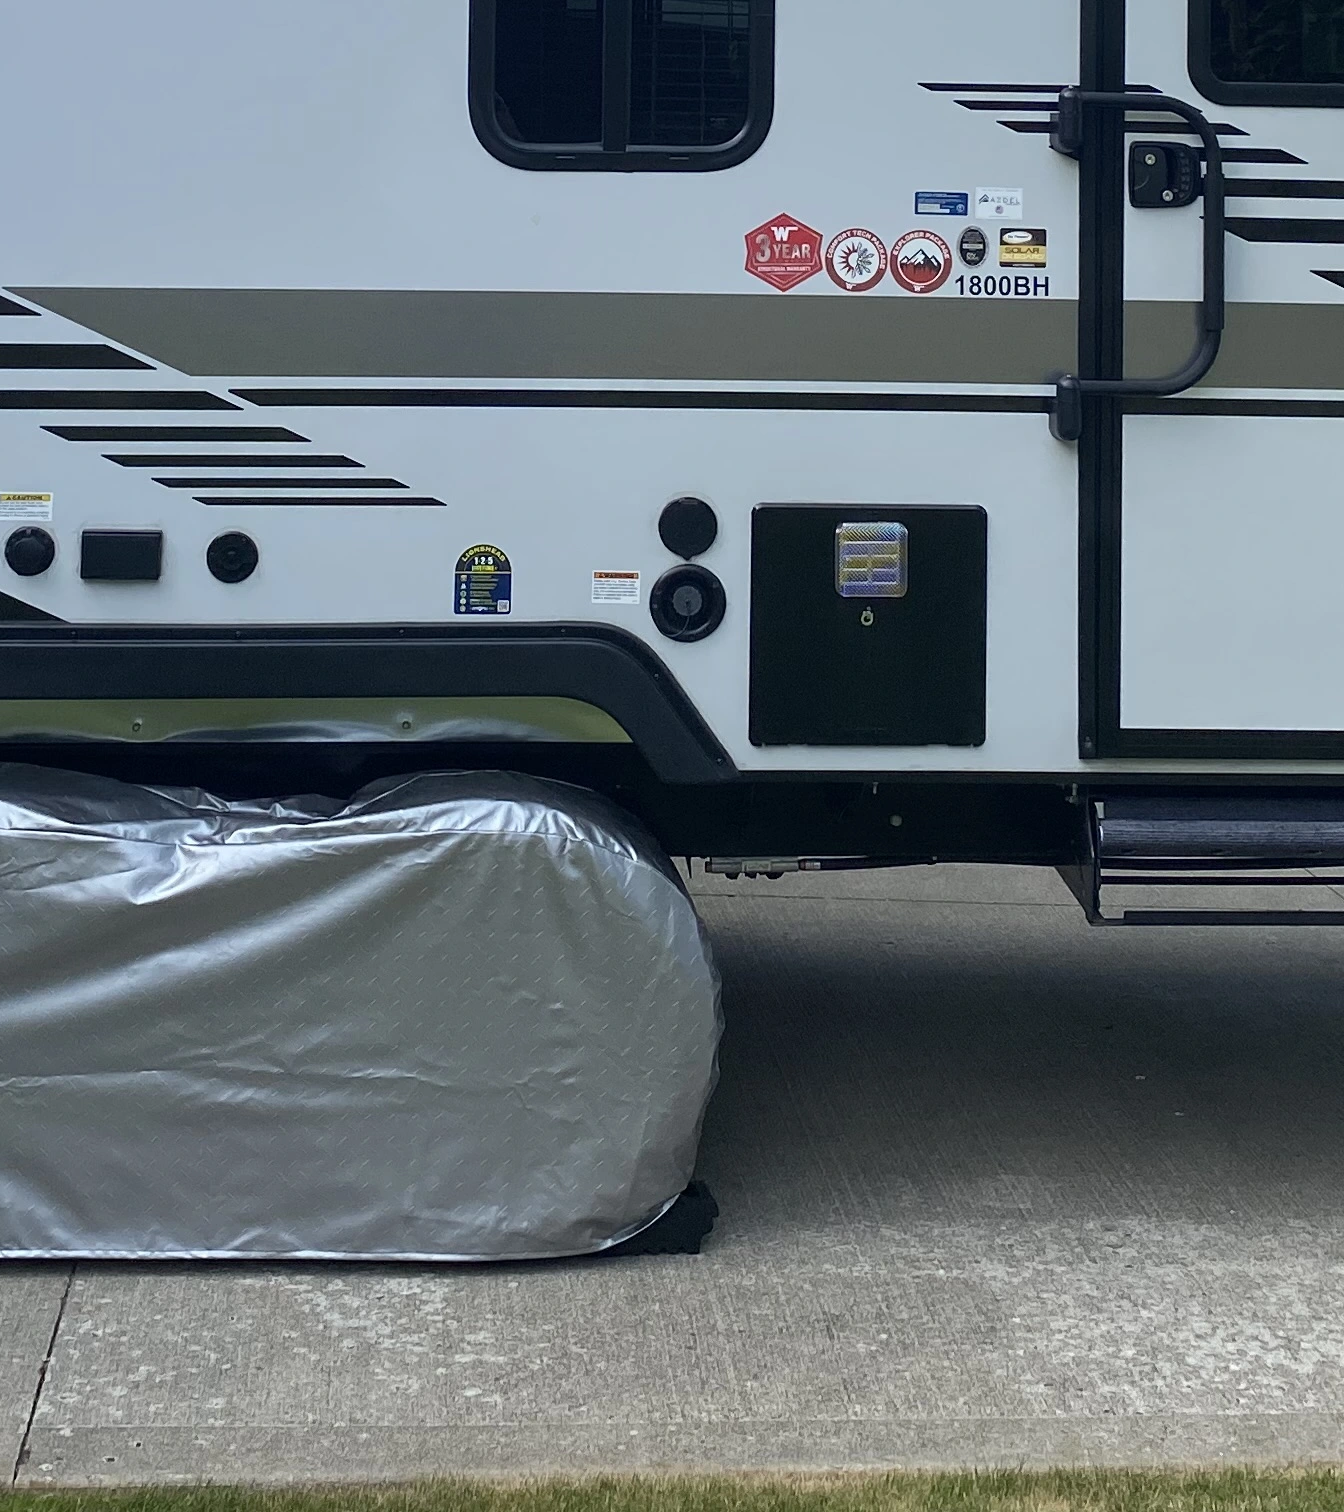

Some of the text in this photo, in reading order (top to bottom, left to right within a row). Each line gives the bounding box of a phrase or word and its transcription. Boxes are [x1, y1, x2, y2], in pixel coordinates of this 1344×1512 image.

[755, 233, 811, 263] 3 YEAR
[826, 229, 886, 270] COMFORT TECH PACKAGE
[892, 231, 925, 256] EXPLORER
[925, 231, 950, 259] PACKAGE
[955, 274, 1050, 296] 1800BH
[461, 546, 506, 562] LIONSHEAD
